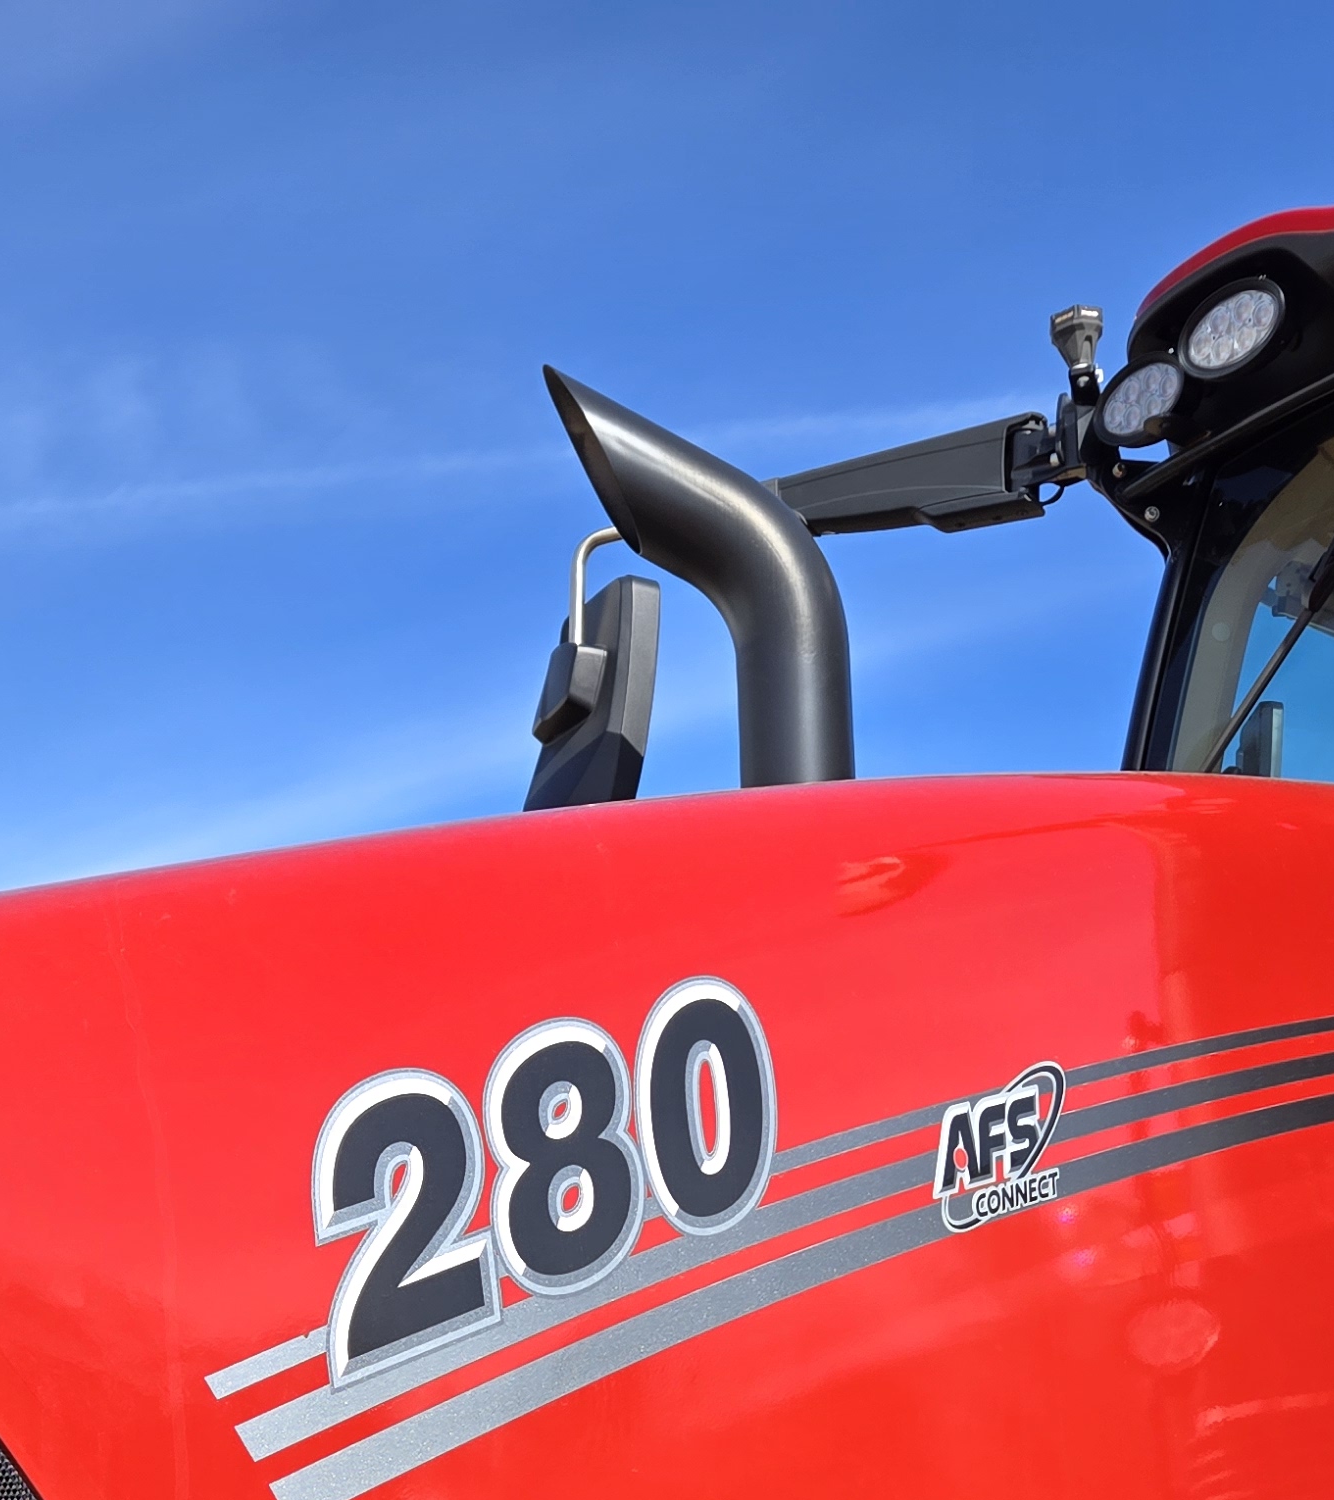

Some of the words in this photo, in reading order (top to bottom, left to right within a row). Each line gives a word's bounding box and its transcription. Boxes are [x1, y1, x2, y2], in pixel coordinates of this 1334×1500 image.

[311, 975, 778, 1394] 280
[933, 1084, 1042, 1200] AFS
[973, 1168, 1059, 1218] CONNECT
